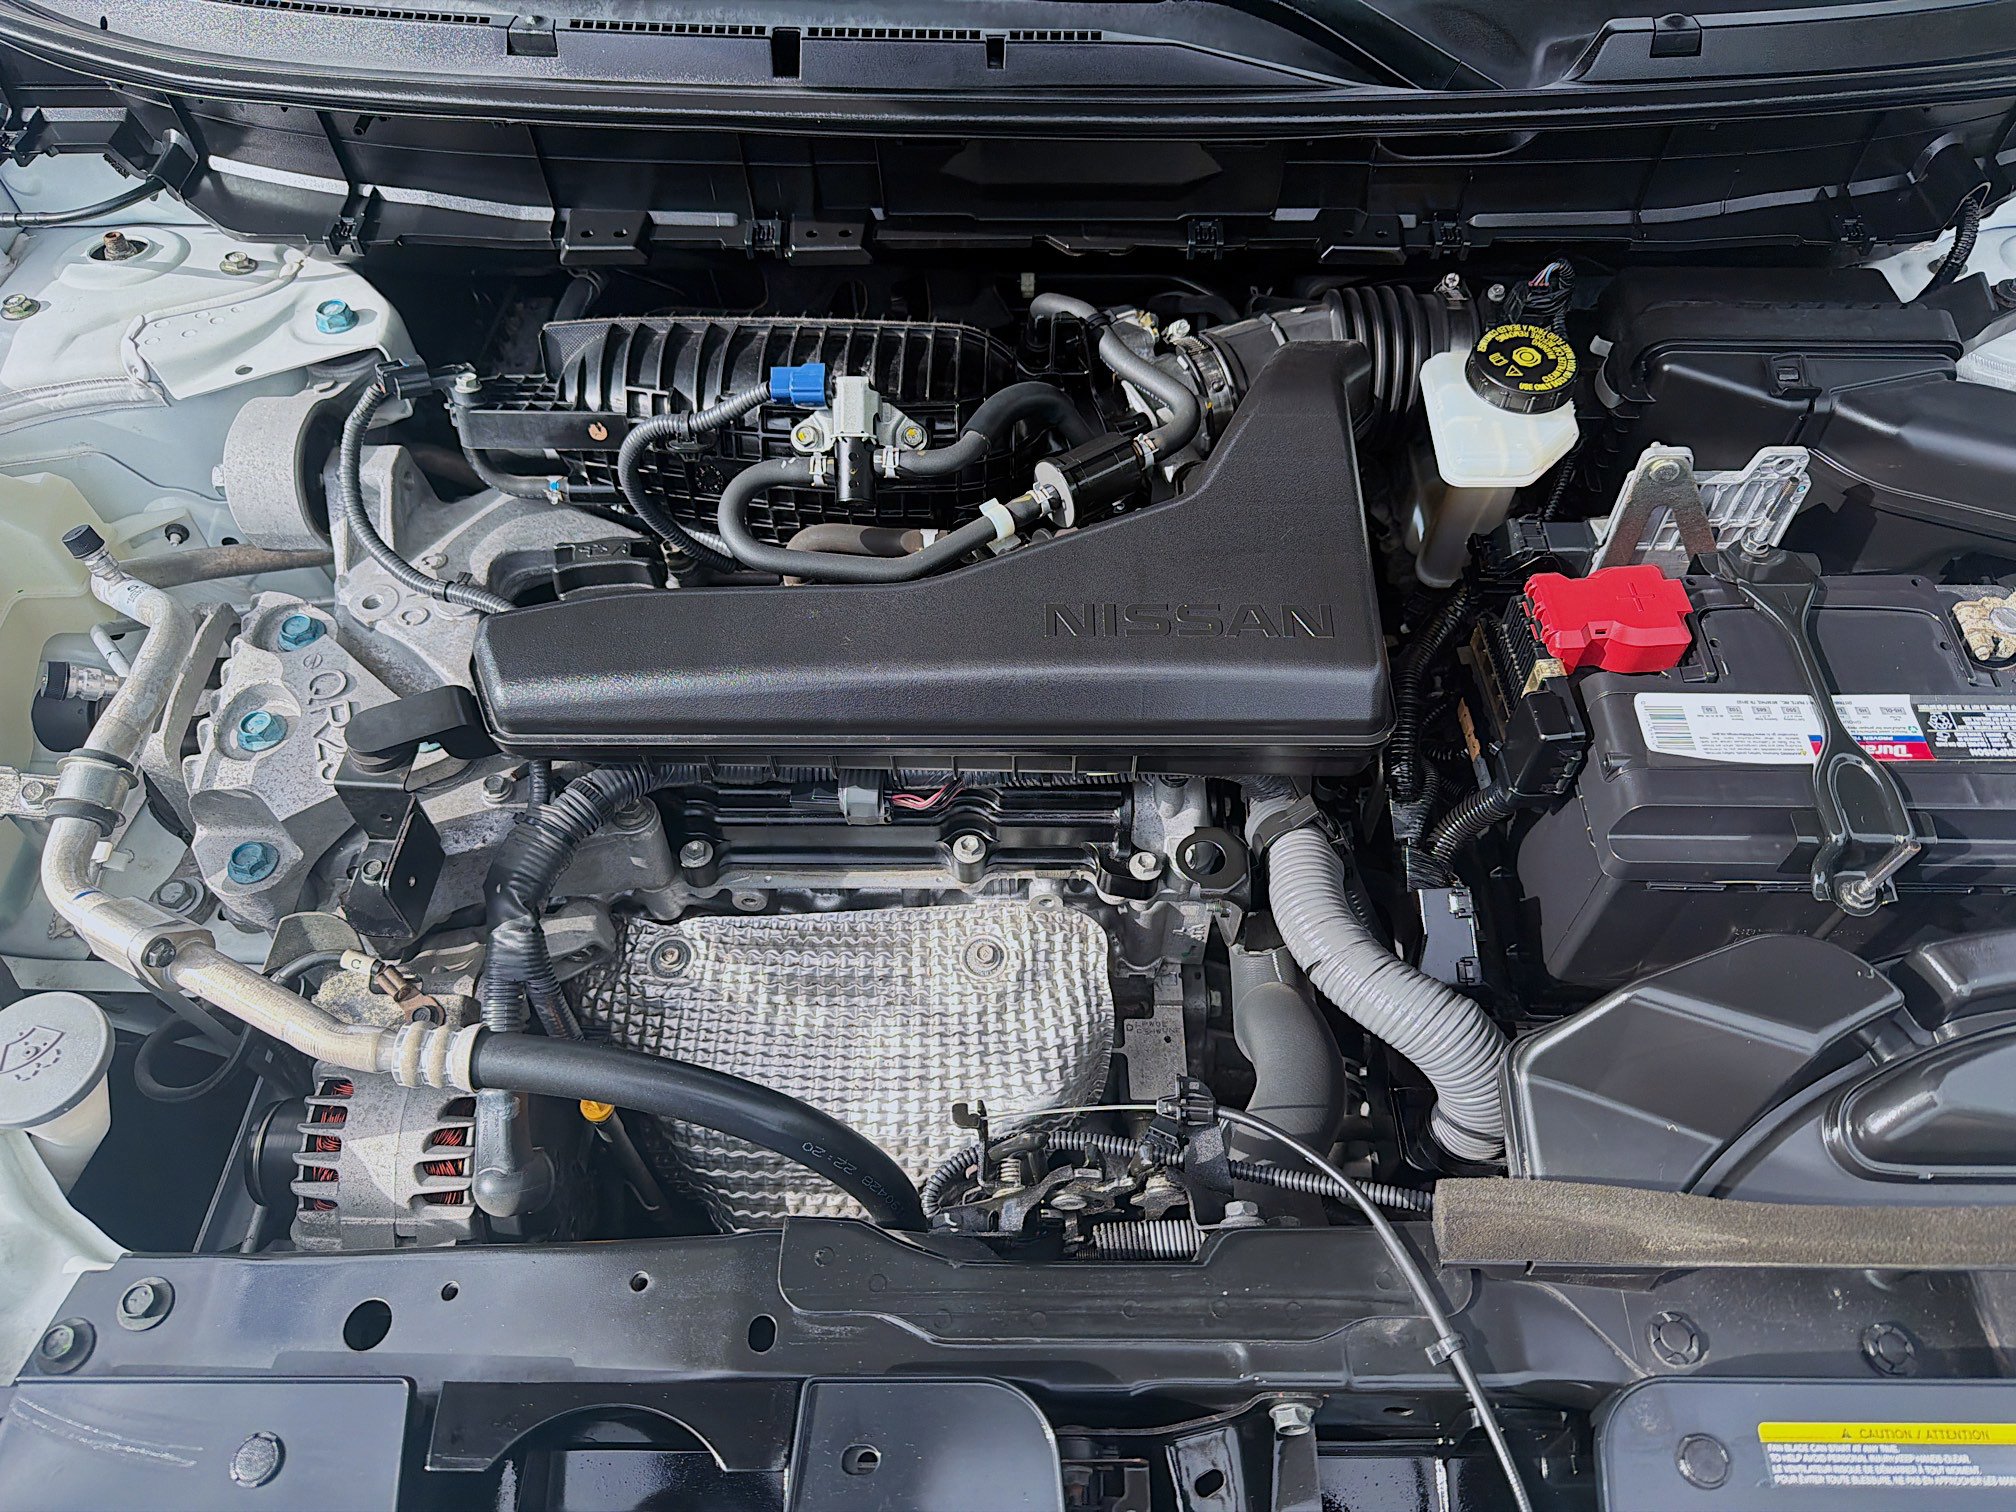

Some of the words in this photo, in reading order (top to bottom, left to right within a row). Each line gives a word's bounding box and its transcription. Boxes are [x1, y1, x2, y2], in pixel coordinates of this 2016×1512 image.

[1045, 603, 1335, 637] NISSAN
[802, 1142, 857, 1175] 22:20
[1860, 1429, 1912, 1439] CAUTION
[1926, 1430, 1990, 1440] ATTENTION
